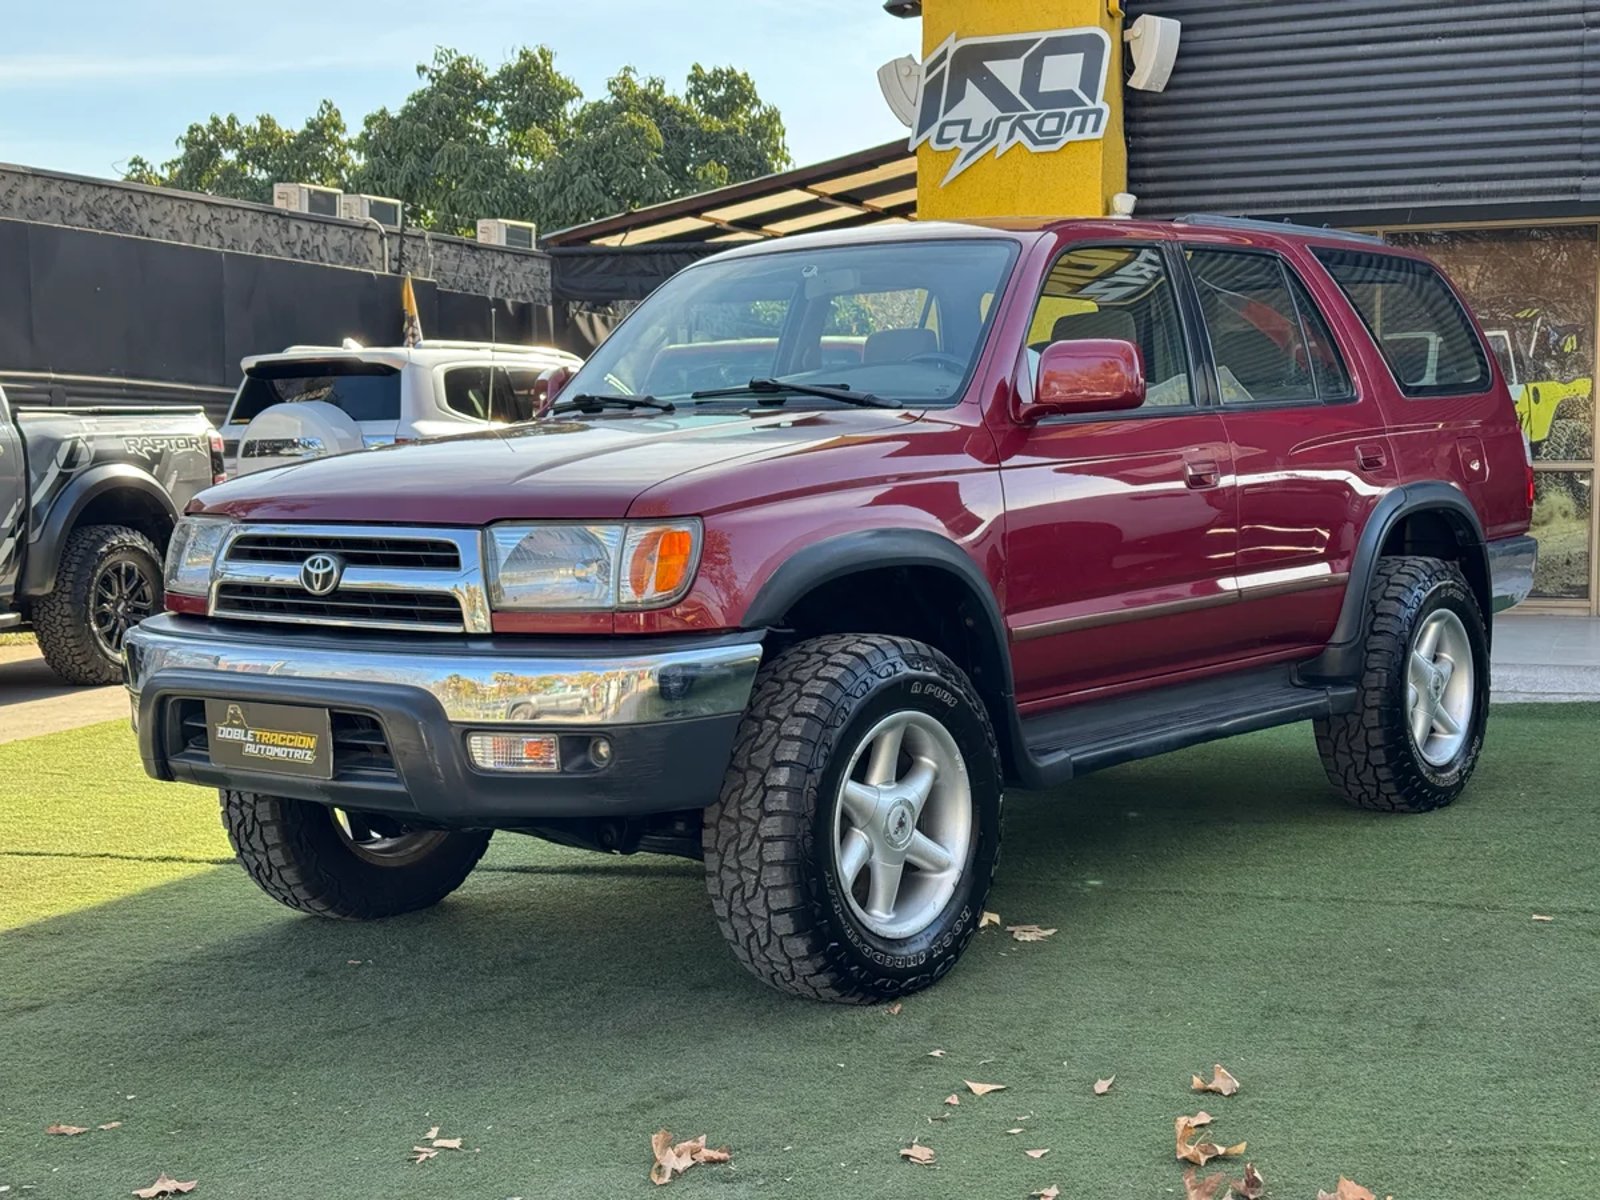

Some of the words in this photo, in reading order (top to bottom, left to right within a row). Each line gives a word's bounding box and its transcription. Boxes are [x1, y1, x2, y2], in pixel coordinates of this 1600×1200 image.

[122, 436, 208, 459] RAPTOR
[244, 743, 313, 761] AUTOMOTRIZ
[931, 905, 972, 959] ROCK
